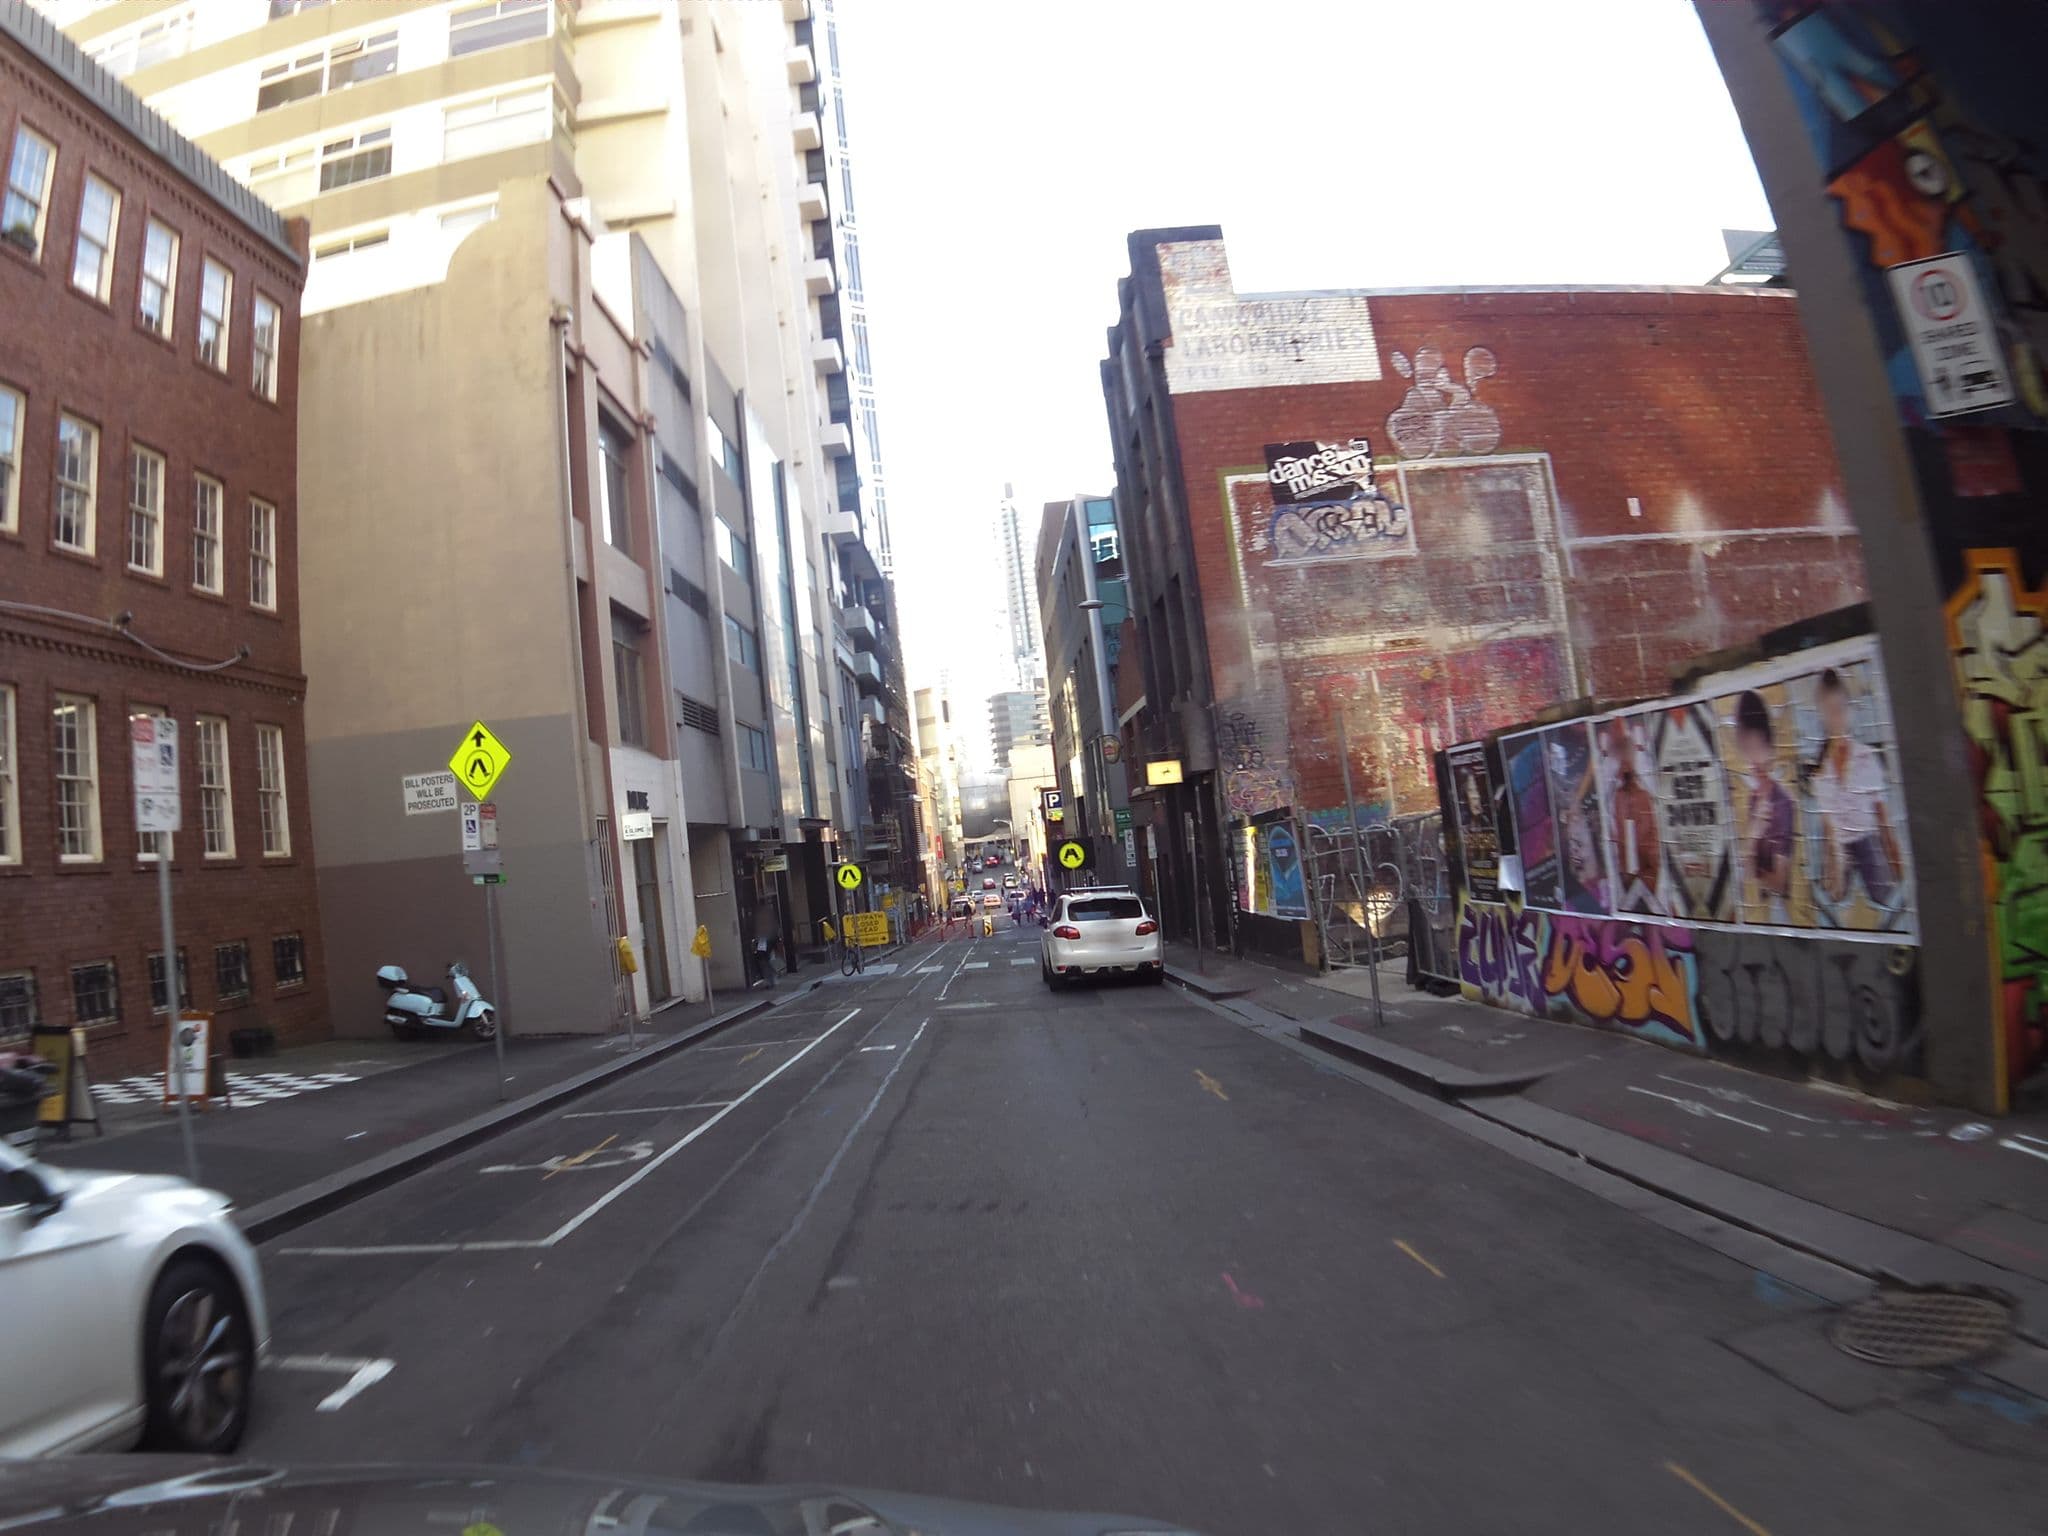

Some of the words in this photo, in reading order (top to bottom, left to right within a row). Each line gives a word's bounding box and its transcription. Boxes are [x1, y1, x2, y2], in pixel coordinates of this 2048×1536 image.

[1269, 449, 1338, 484] dance
[405, 777, 419, 789] BILL
[421, 774, 454, 786] POSTERS
[416, 789, 432, 799] WILL
[434, 787, 444, 797] BE
[407, 797, 455, 811] PROSECUTED
[1050, 794, 1059, 806] P
[463, 804, 477, 816] 2P
